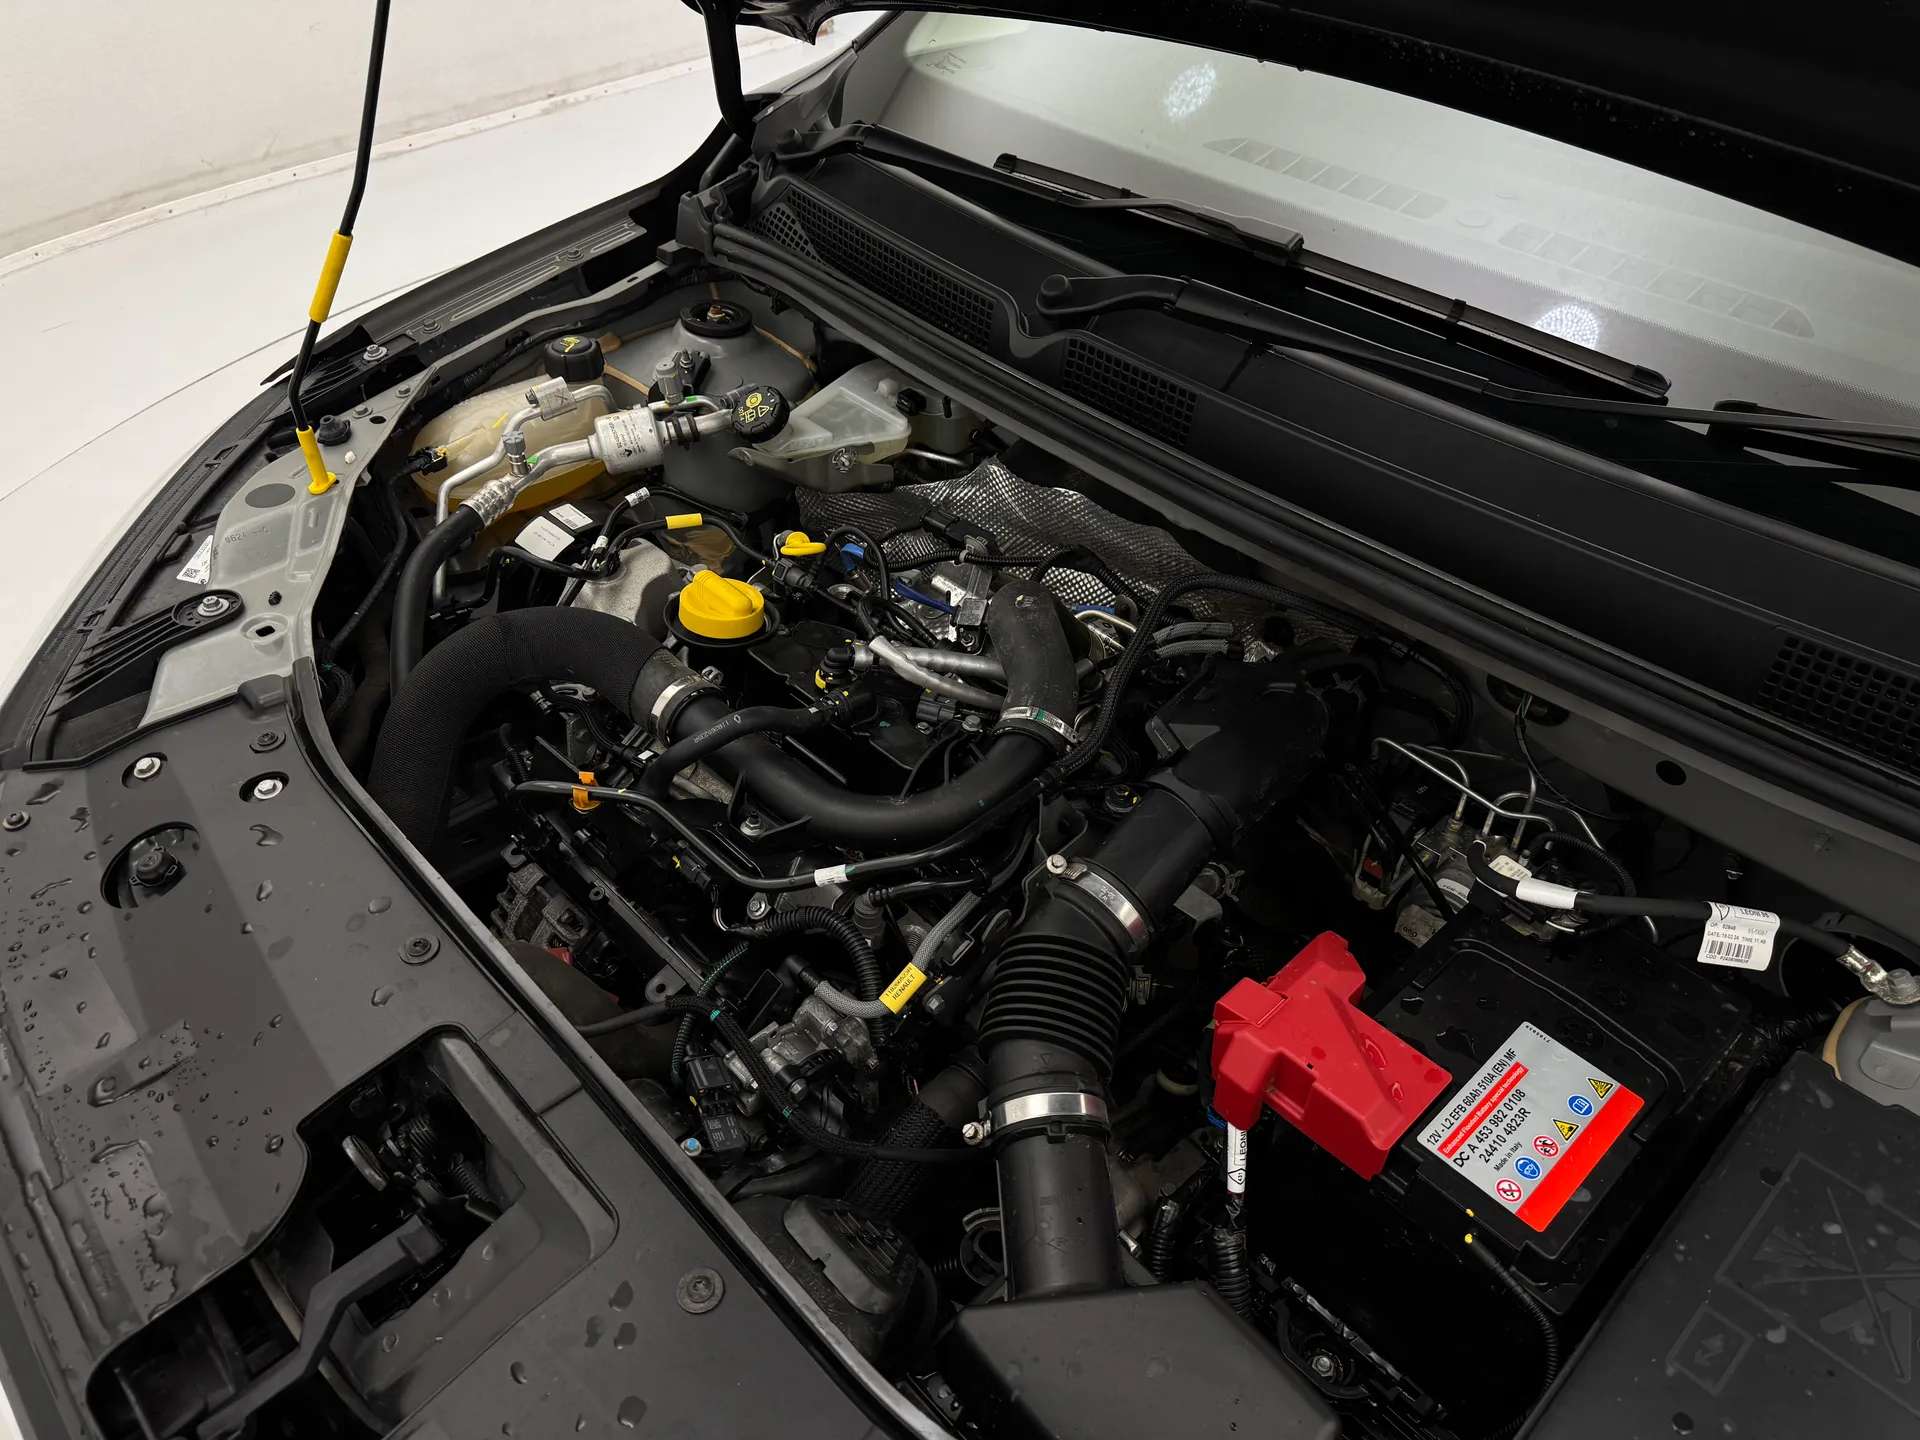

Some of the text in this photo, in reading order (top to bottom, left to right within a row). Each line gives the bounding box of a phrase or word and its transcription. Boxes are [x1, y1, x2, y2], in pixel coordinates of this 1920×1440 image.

[892, 974, 915, 1000] RENAULT
[1426, 1130, 1443, 1146] 12V
[1440, 1117, 1455, 1130] L2
[1449, 1104, 1467, 1121] EFB
[1462, 1088, 1482, 1107] 60Ah
[1477, 1072, 1497, 1090] 510A
[1492, 1058, 1511, 1077] (EN)
[1503, 1047, 1517, 1062] MF
[1453, 1088, 1526, 1168] DC A 453 982 0108
[1478, 1107, 1531, 1164] 24410 4823R
[1493, 1156, 1509, 1172] Made
[1509, 1141, 1523, 1155] Italy
